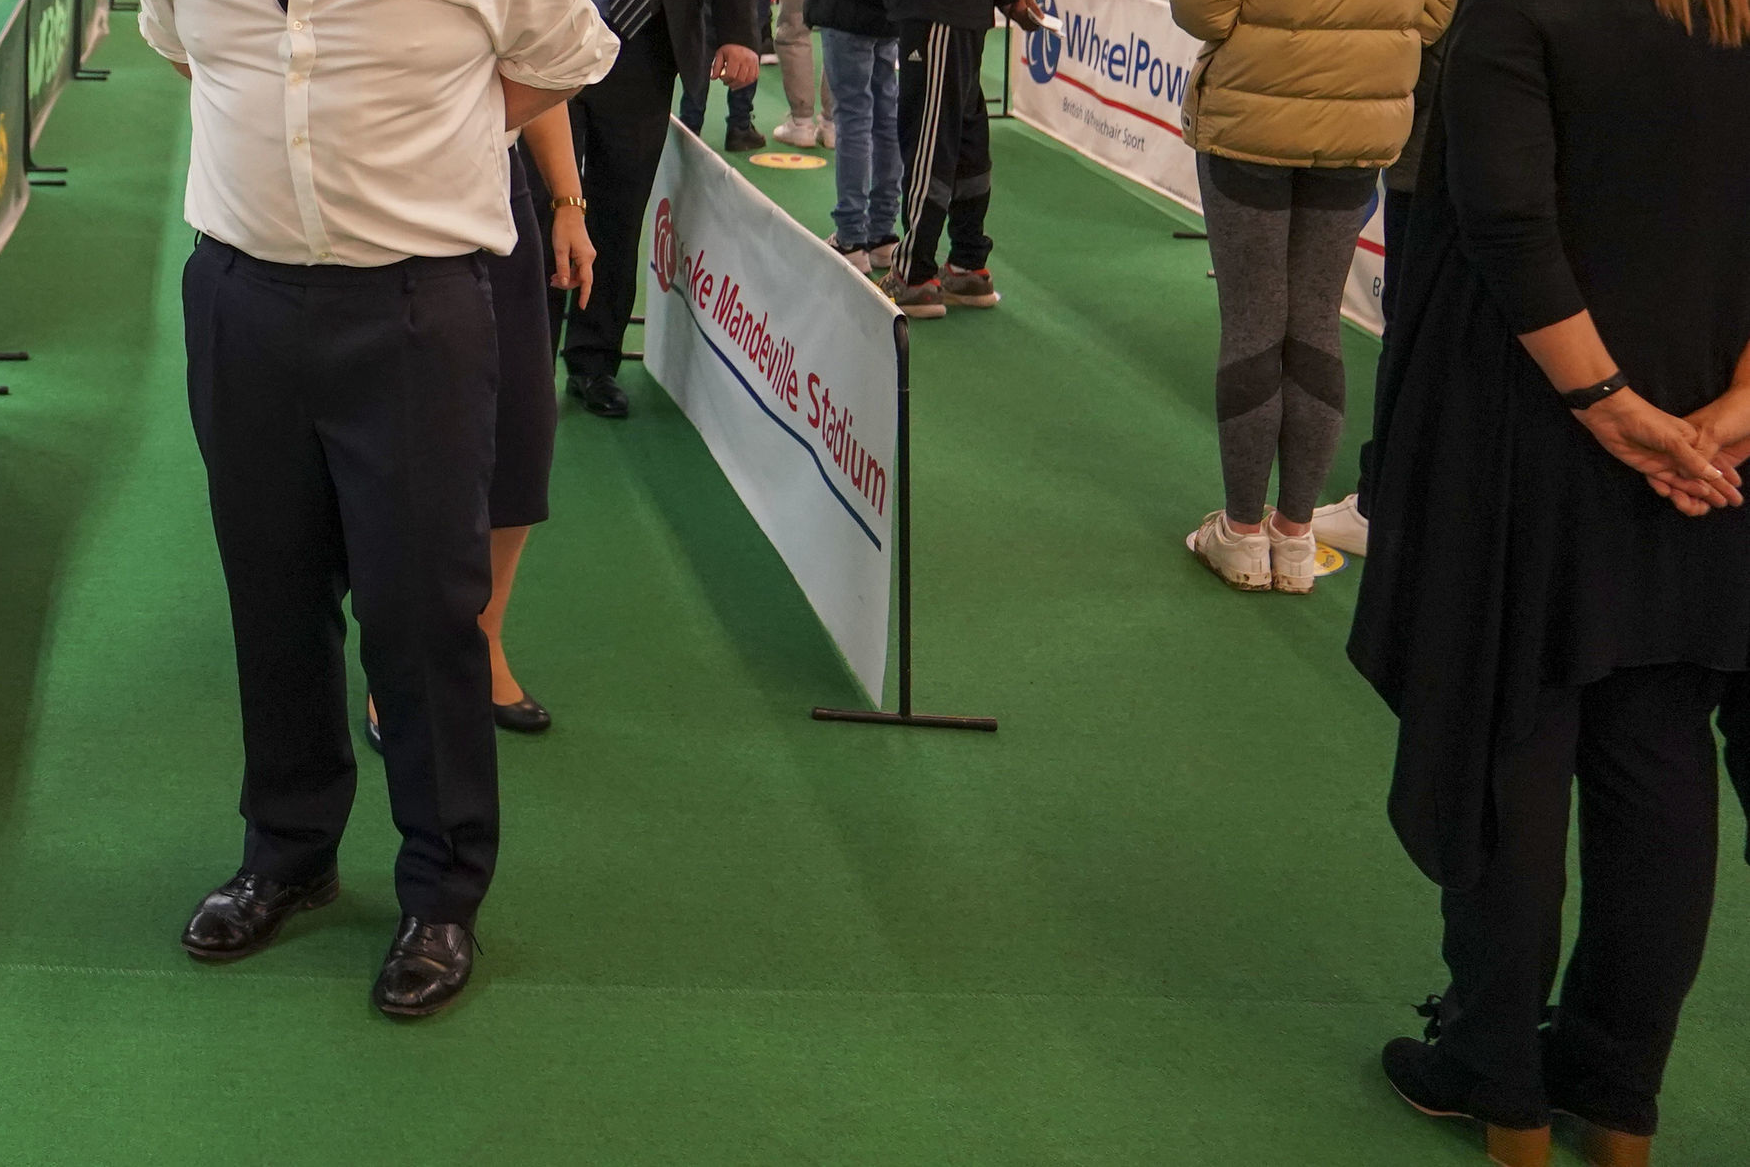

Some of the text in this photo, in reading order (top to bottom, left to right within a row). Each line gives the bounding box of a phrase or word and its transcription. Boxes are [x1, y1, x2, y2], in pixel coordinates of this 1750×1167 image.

[1122, 127, 1145, 153] Sport
[712, 274, 798, 412] Mandeville
[807, 372, 887, 516] Stadium
